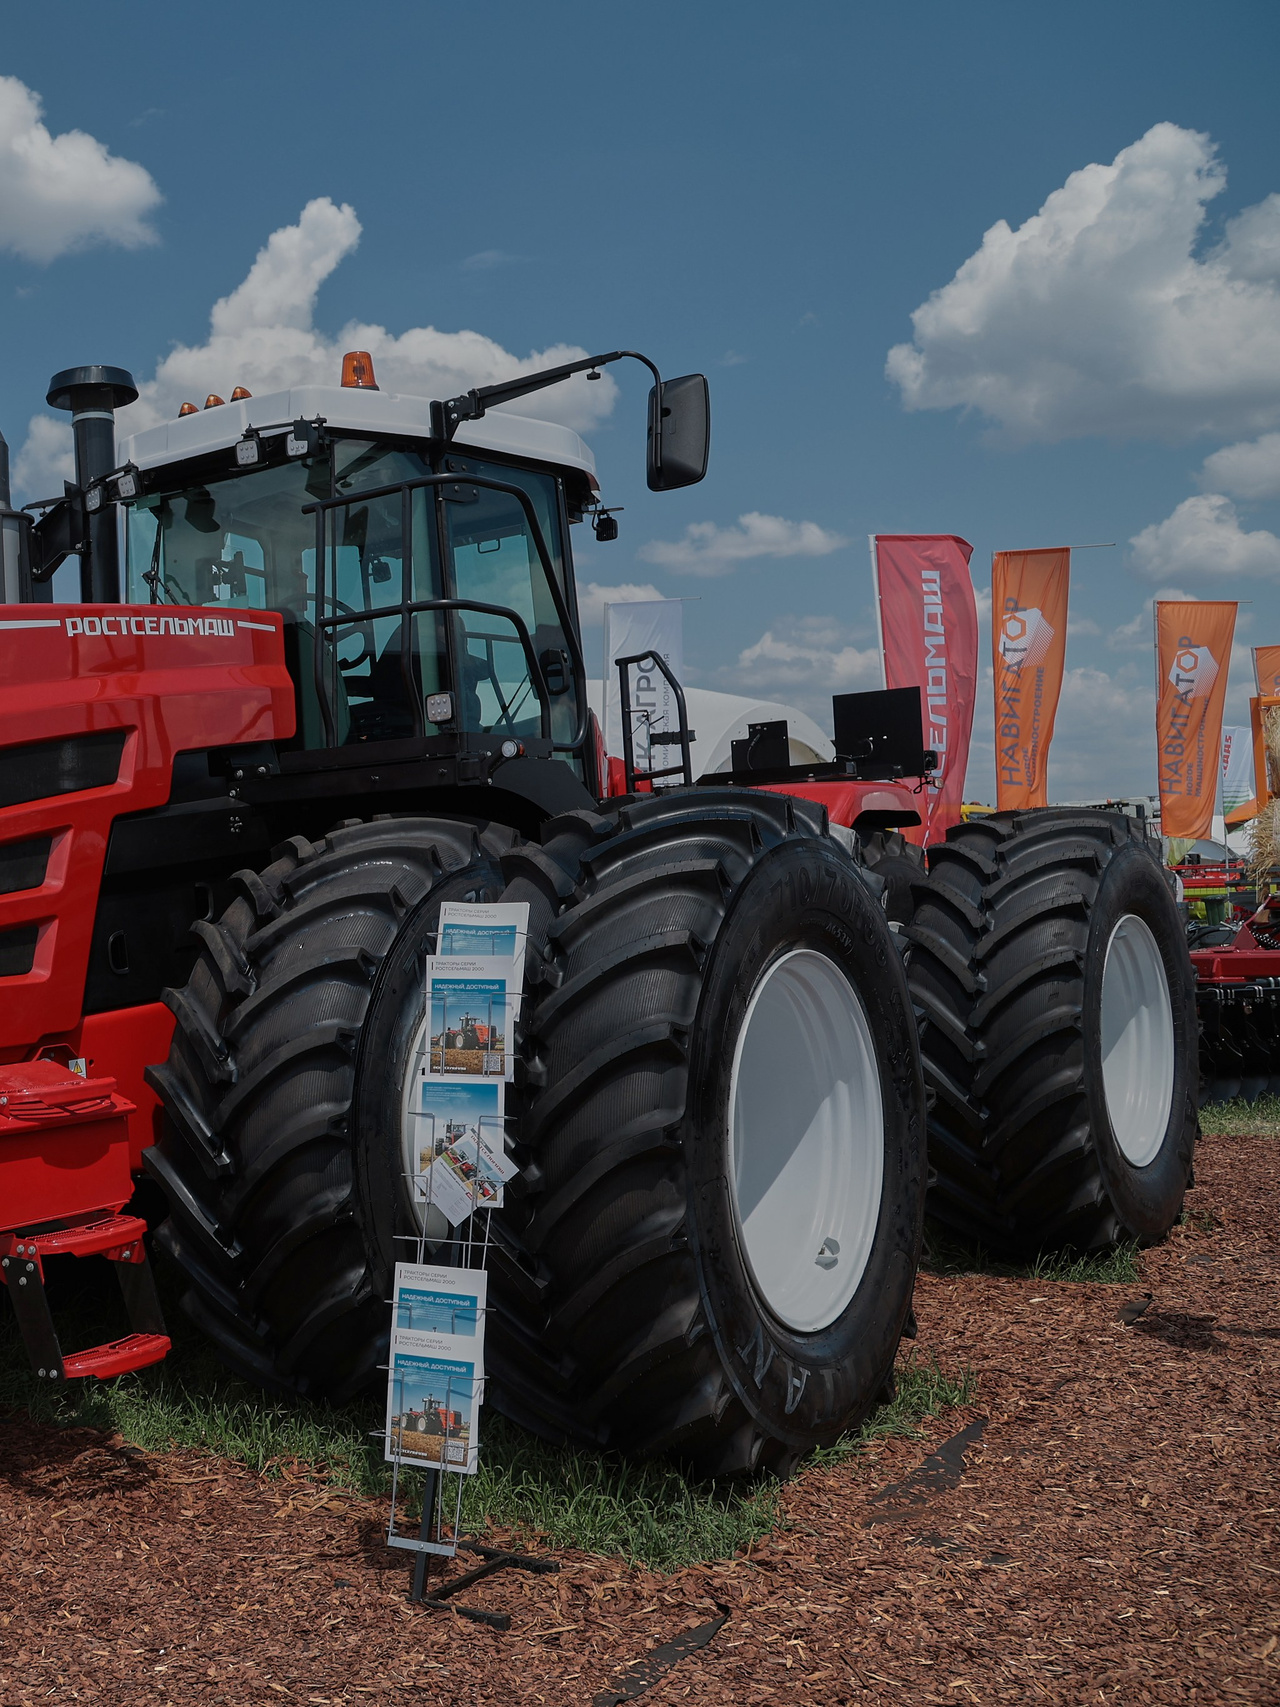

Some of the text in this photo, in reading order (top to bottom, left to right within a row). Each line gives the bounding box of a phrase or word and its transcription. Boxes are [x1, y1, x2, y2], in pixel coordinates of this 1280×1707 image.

[65, 616, 235, 637] РОСТСЕЛЬМАШ
[1000, 597, 1028, 787] НАВИГАТОР
[1161, 636, 1200, 796] НАВИГАТОР
[1186, 762, 1194, 796] НОВОЕ
